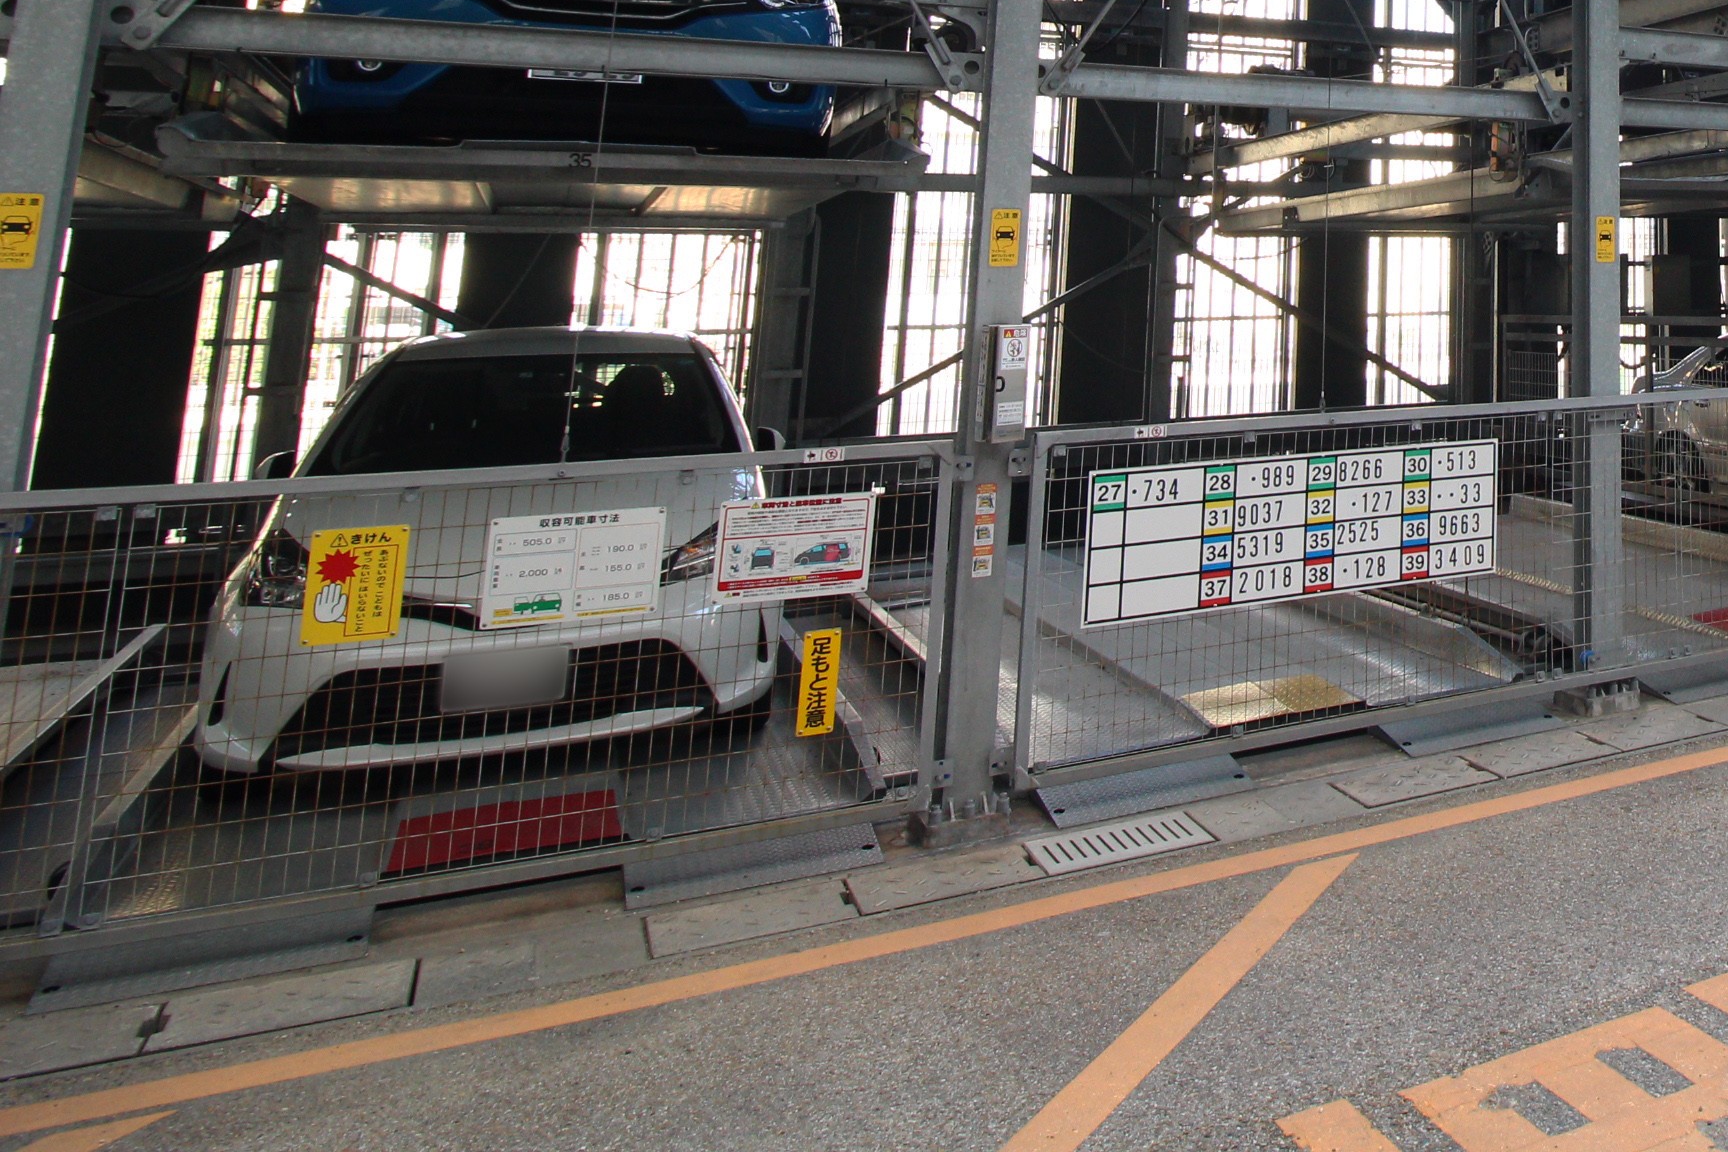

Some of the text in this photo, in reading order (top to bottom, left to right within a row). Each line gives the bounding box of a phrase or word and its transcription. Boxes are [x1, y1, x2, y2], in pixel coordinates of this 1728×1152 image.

[568, 153, 592, 168] 35
[1098, 484, 1122, 503] 27
[1209, 474, 1231, 492] 28
[1312, 465, 1332, 481] 29
[1339, 458, 1383, 482] 8266
[1407, 457, 1427, 473] 30
[1208, 509, 1229, 526] 31
[1237, 500, 1283, 527] 9037
[1310, 499, 1331, 515] 32
[1406, 489, 1427, 506] 33
[539, 513, 620, 528] 収容可能車寸法
[350, 532, 391, 545] きけん
[522, 536, 552, 547] 505.0
[1205, 512, 1480, 562] 34 5319 35 2525 36 9663
[606, 544, 634, 554] 190.0
[604, 562, 632, 573] 155.0
[1204, 579, 1227, 597] 37
[1239, 565, 1292, 594] 2018
[1308, 566, 1329, 584] 38
[1405, 554, 1425, 571] 39
[1435, 544, 1485, 569] 3409
[602, 591, 630, 602] 185.0
[804, 636, 832, 729] 足もと注意
